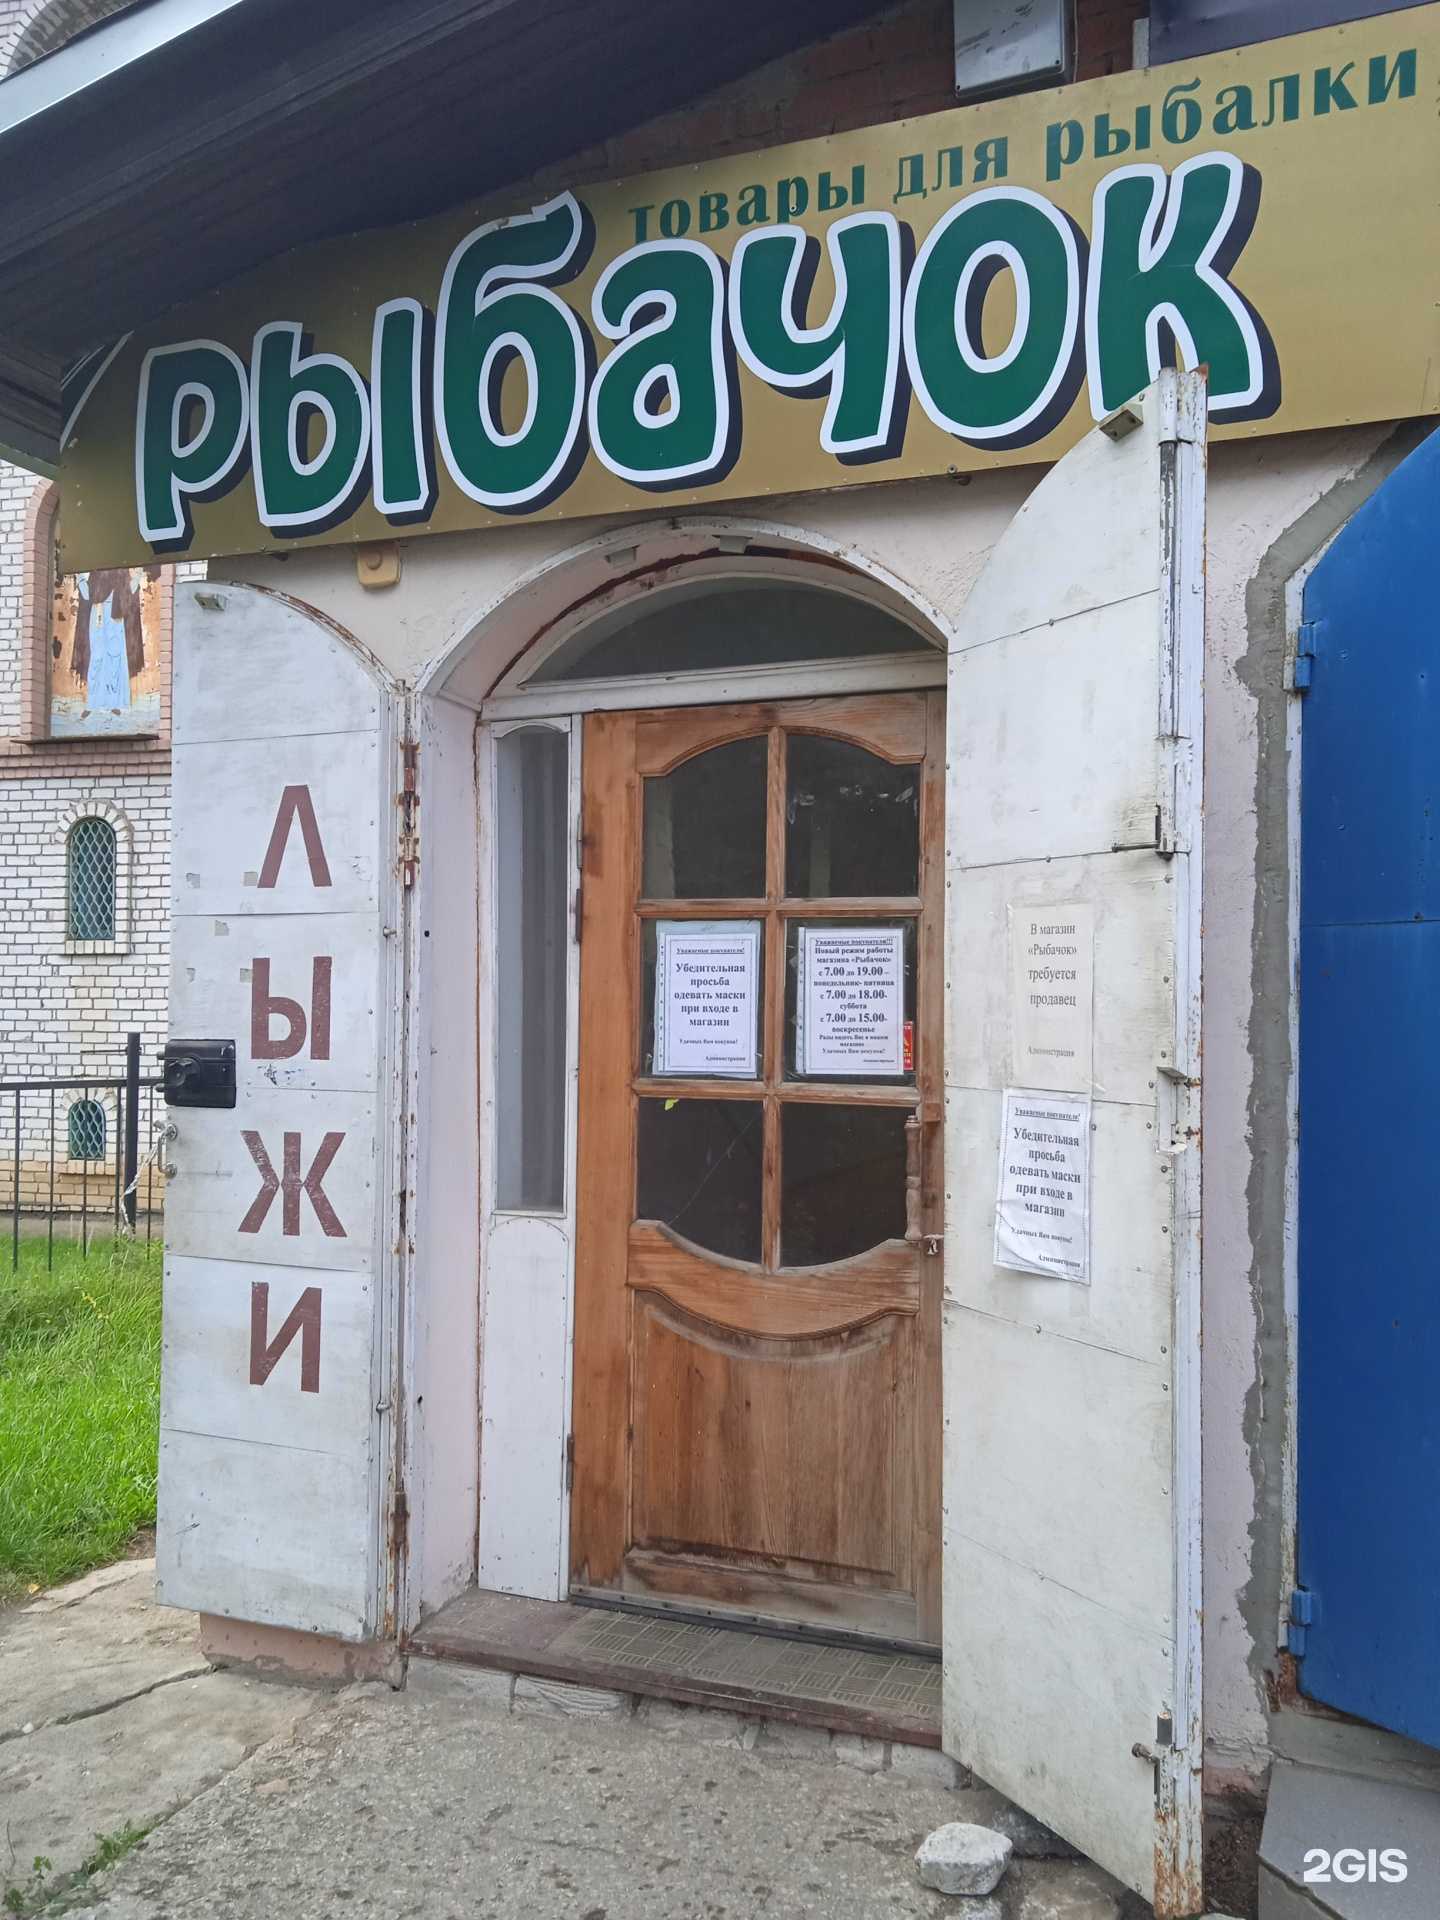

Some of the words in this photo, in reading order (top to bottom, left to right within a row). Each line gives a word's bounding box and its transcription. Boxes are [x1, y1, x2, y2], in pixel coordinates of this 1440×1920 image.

[628, 163, 866, 242] товары
[893, 135, 1008, 203] для
[1046, 48, 1418, 181] рыбалки
[1030, 923, 1037, 935] В
[1040, 924, 1076, 935] магазин
[866, 946, 894, 955] работы
[1028, 943, 1077, 956] «Рыбачок»
[675, 962, 746, 974] Убедительная
[824, 966, 845, 976] 7.00
[857, 966, 883, 976] 19.00
[1028, 966, 1077, 983] требуется
[690, 976, 730, 987] просьба
[674, 992, 713, 1001] одевать
[714, 992, 746, 1000] маски
[826, 990, 846, 999] 7.00
[1030, 993, 1077, 1008] продавец
[681, 1004, 700, 1015] при
[702, 1004, 730, 1014] входе
[732, 1005, 739, 1013] в
[840, 1003, 867, 1011] суббота
[689, 1018, 730, 1027] магазин
[826, 1013, 846, 1022] 7.00
[238, 784, 347, 1393] ЛЫЖИ
[1013, 1127, 1080, 1147] Убедительная
[1028, 1149, 1066, 1163] просьба
[1009, 1165, 1050, 1179] одевать
[1051, 1170, 1081, 1183] маски
[1016, 1184, 1037, 1197] при
[1040, 1187, 1065, 1200] входе
[1067, 1191, 1073, 1200] в
[1024, 1203, 1065, 1217] магазин
